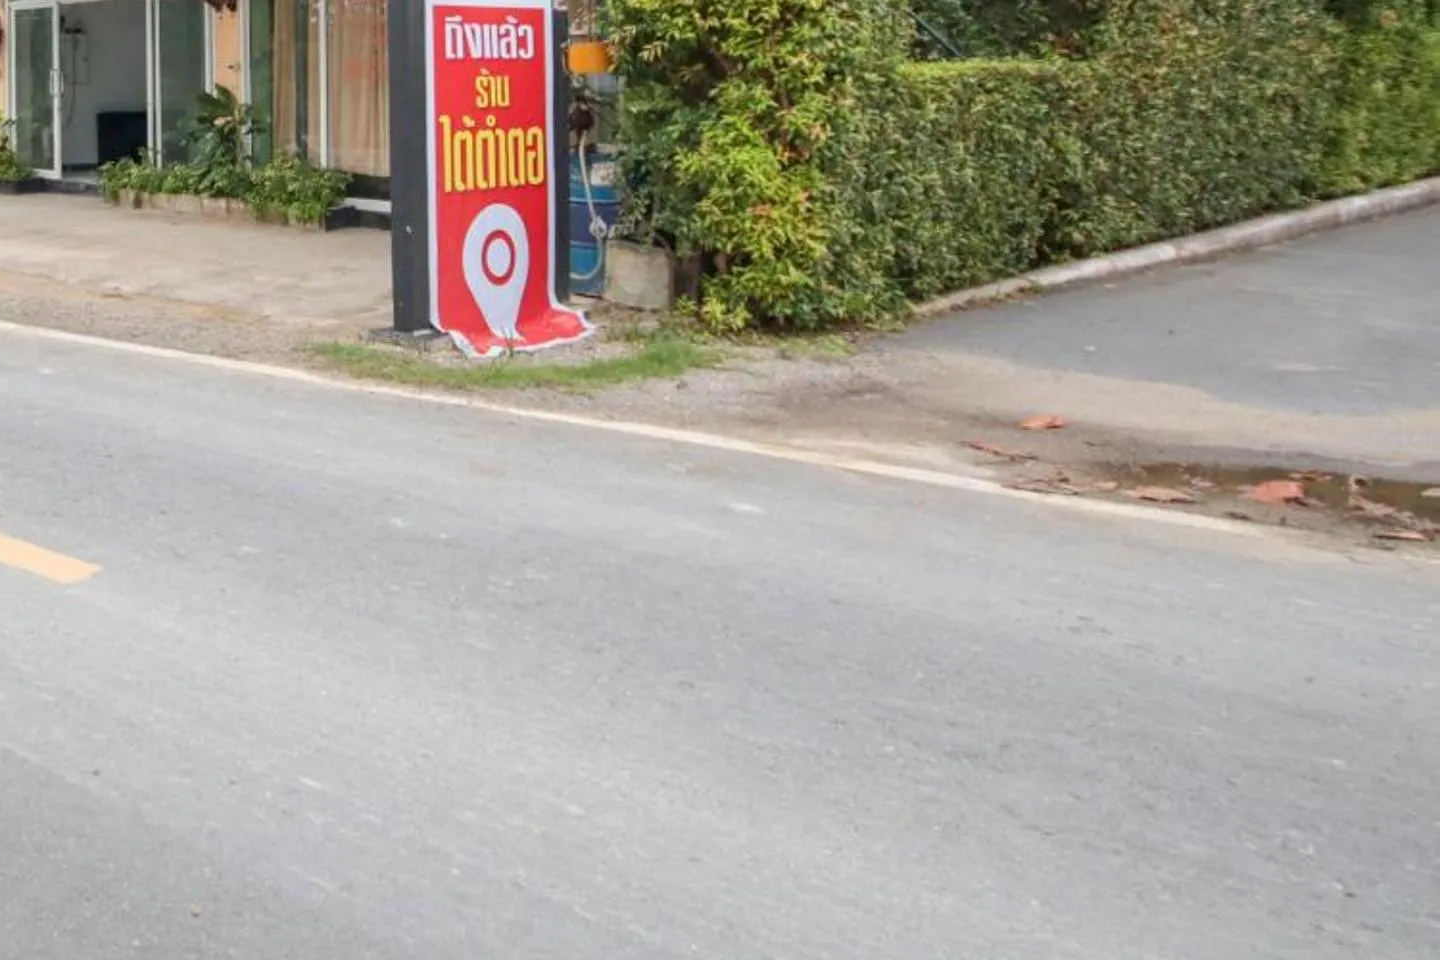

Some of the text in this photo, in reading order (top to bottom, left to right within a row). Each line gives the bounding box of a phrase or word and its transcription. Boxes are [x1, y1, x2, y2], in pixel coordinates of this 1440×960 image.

[444, 15, 533, 59] ถึงแล้ว
[475, 68, 510, 107] ร้าน
